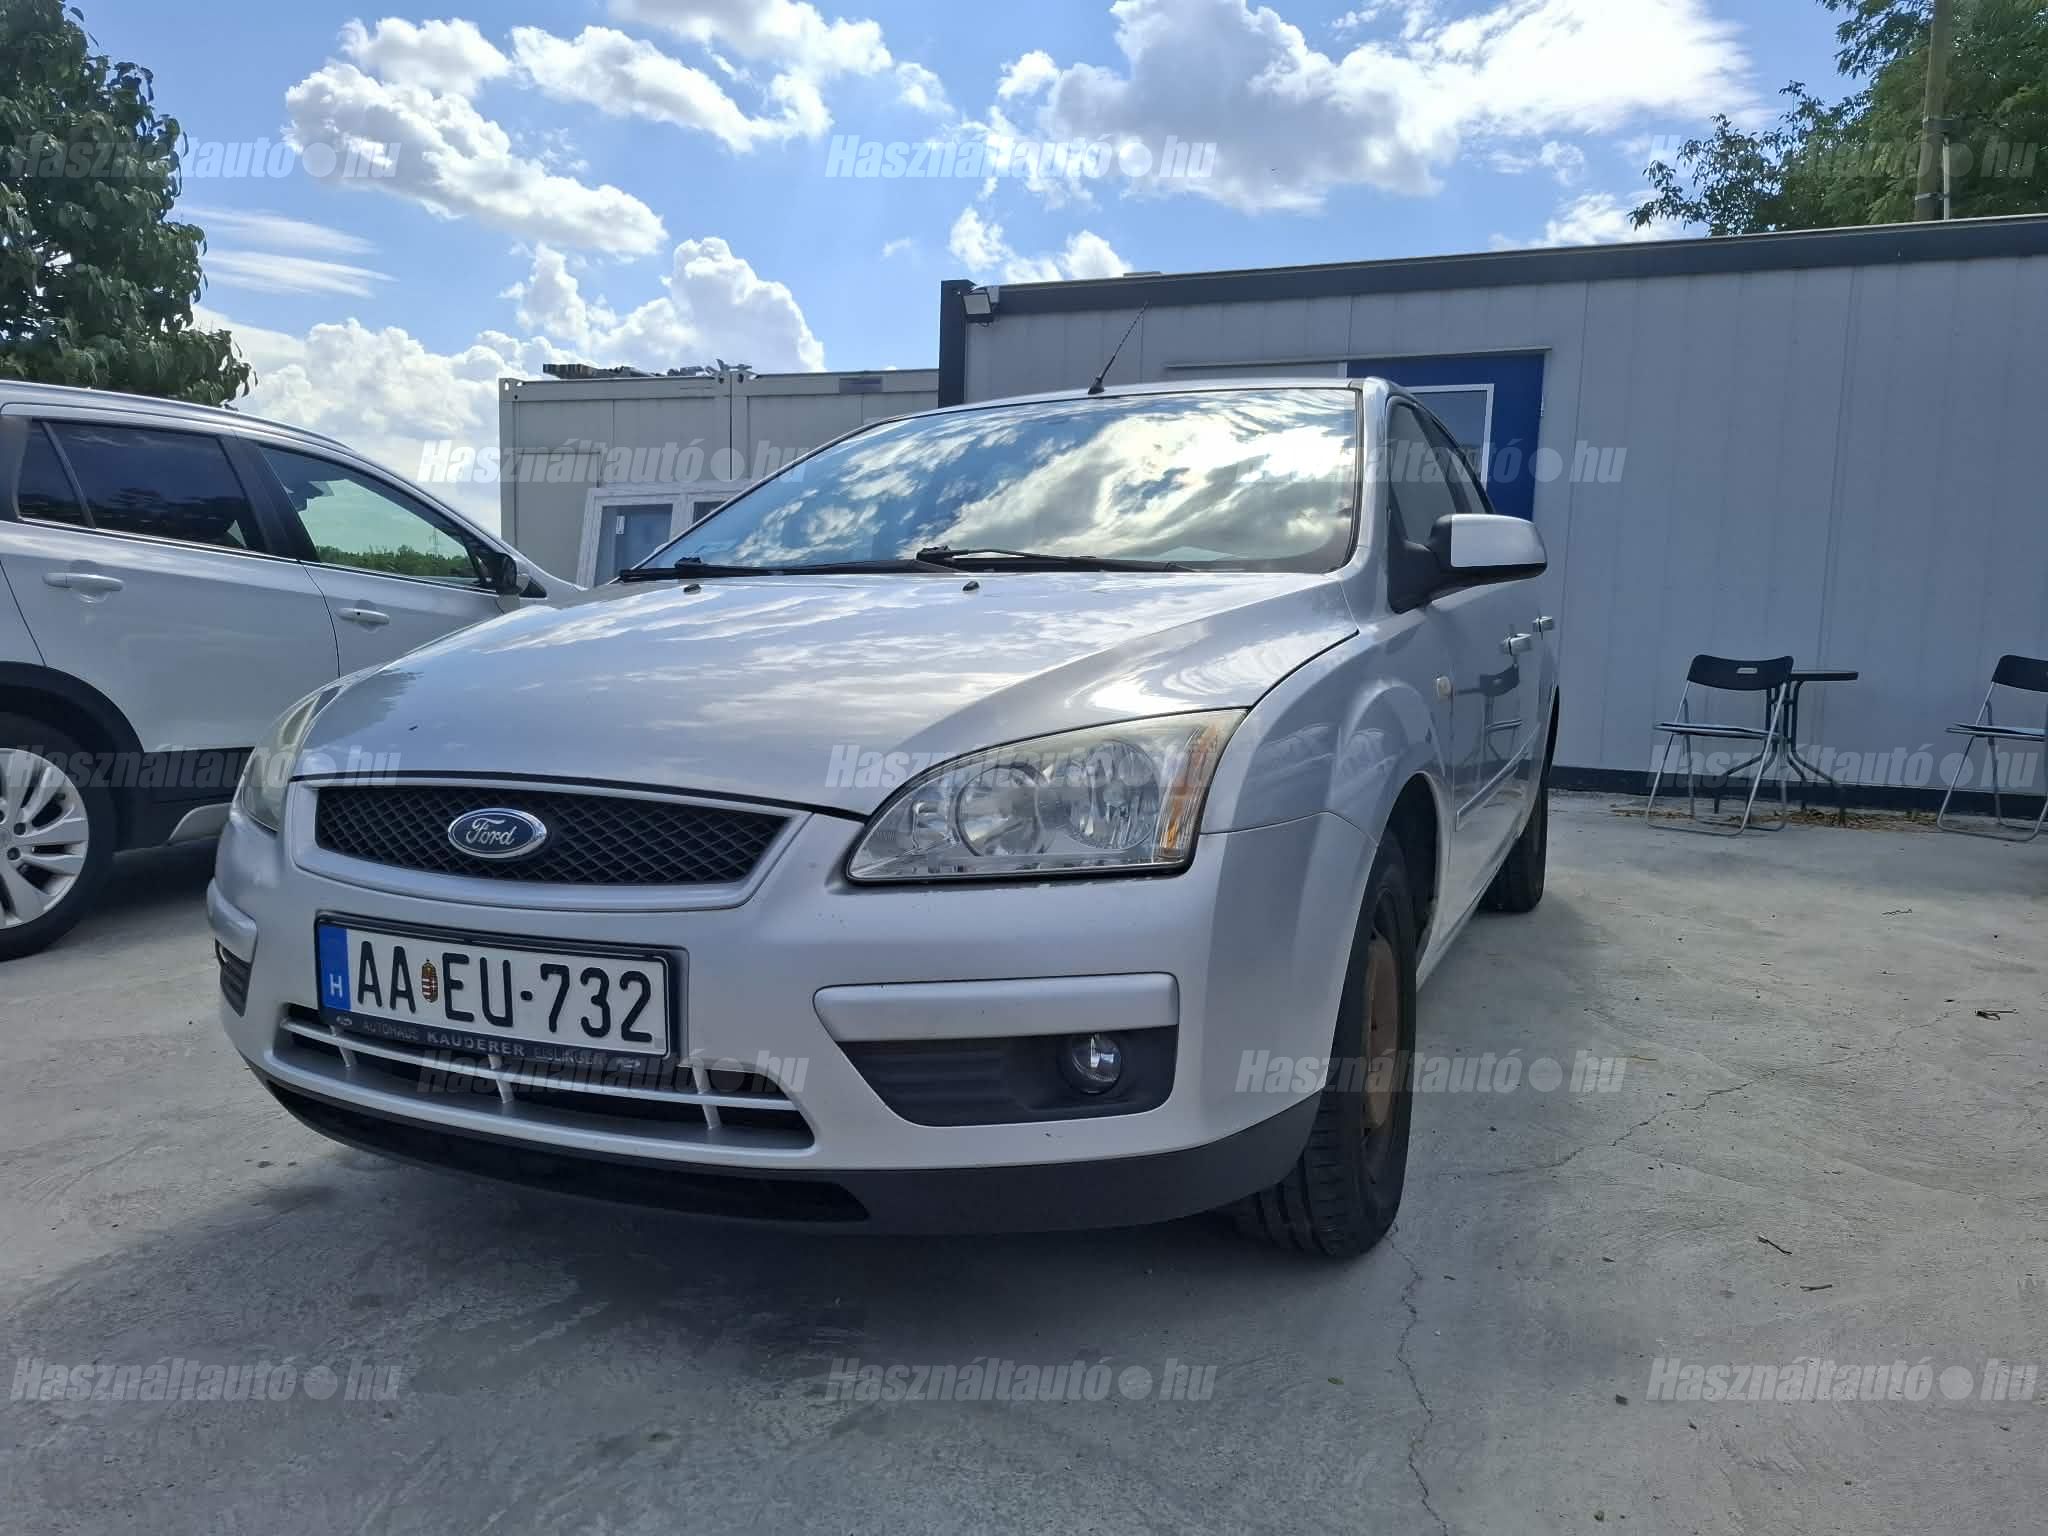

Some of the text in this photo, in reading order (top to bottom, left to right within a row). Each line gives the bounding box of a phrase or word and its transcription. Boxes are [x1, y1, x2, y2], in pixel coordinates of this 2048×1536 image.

[465, 817, 518, 845] Ford
[329, 973, 343, 999] H
[357, 940, 653, 1043] AA EU-732
[427, 1030, 526, 1057] KAUDERER
